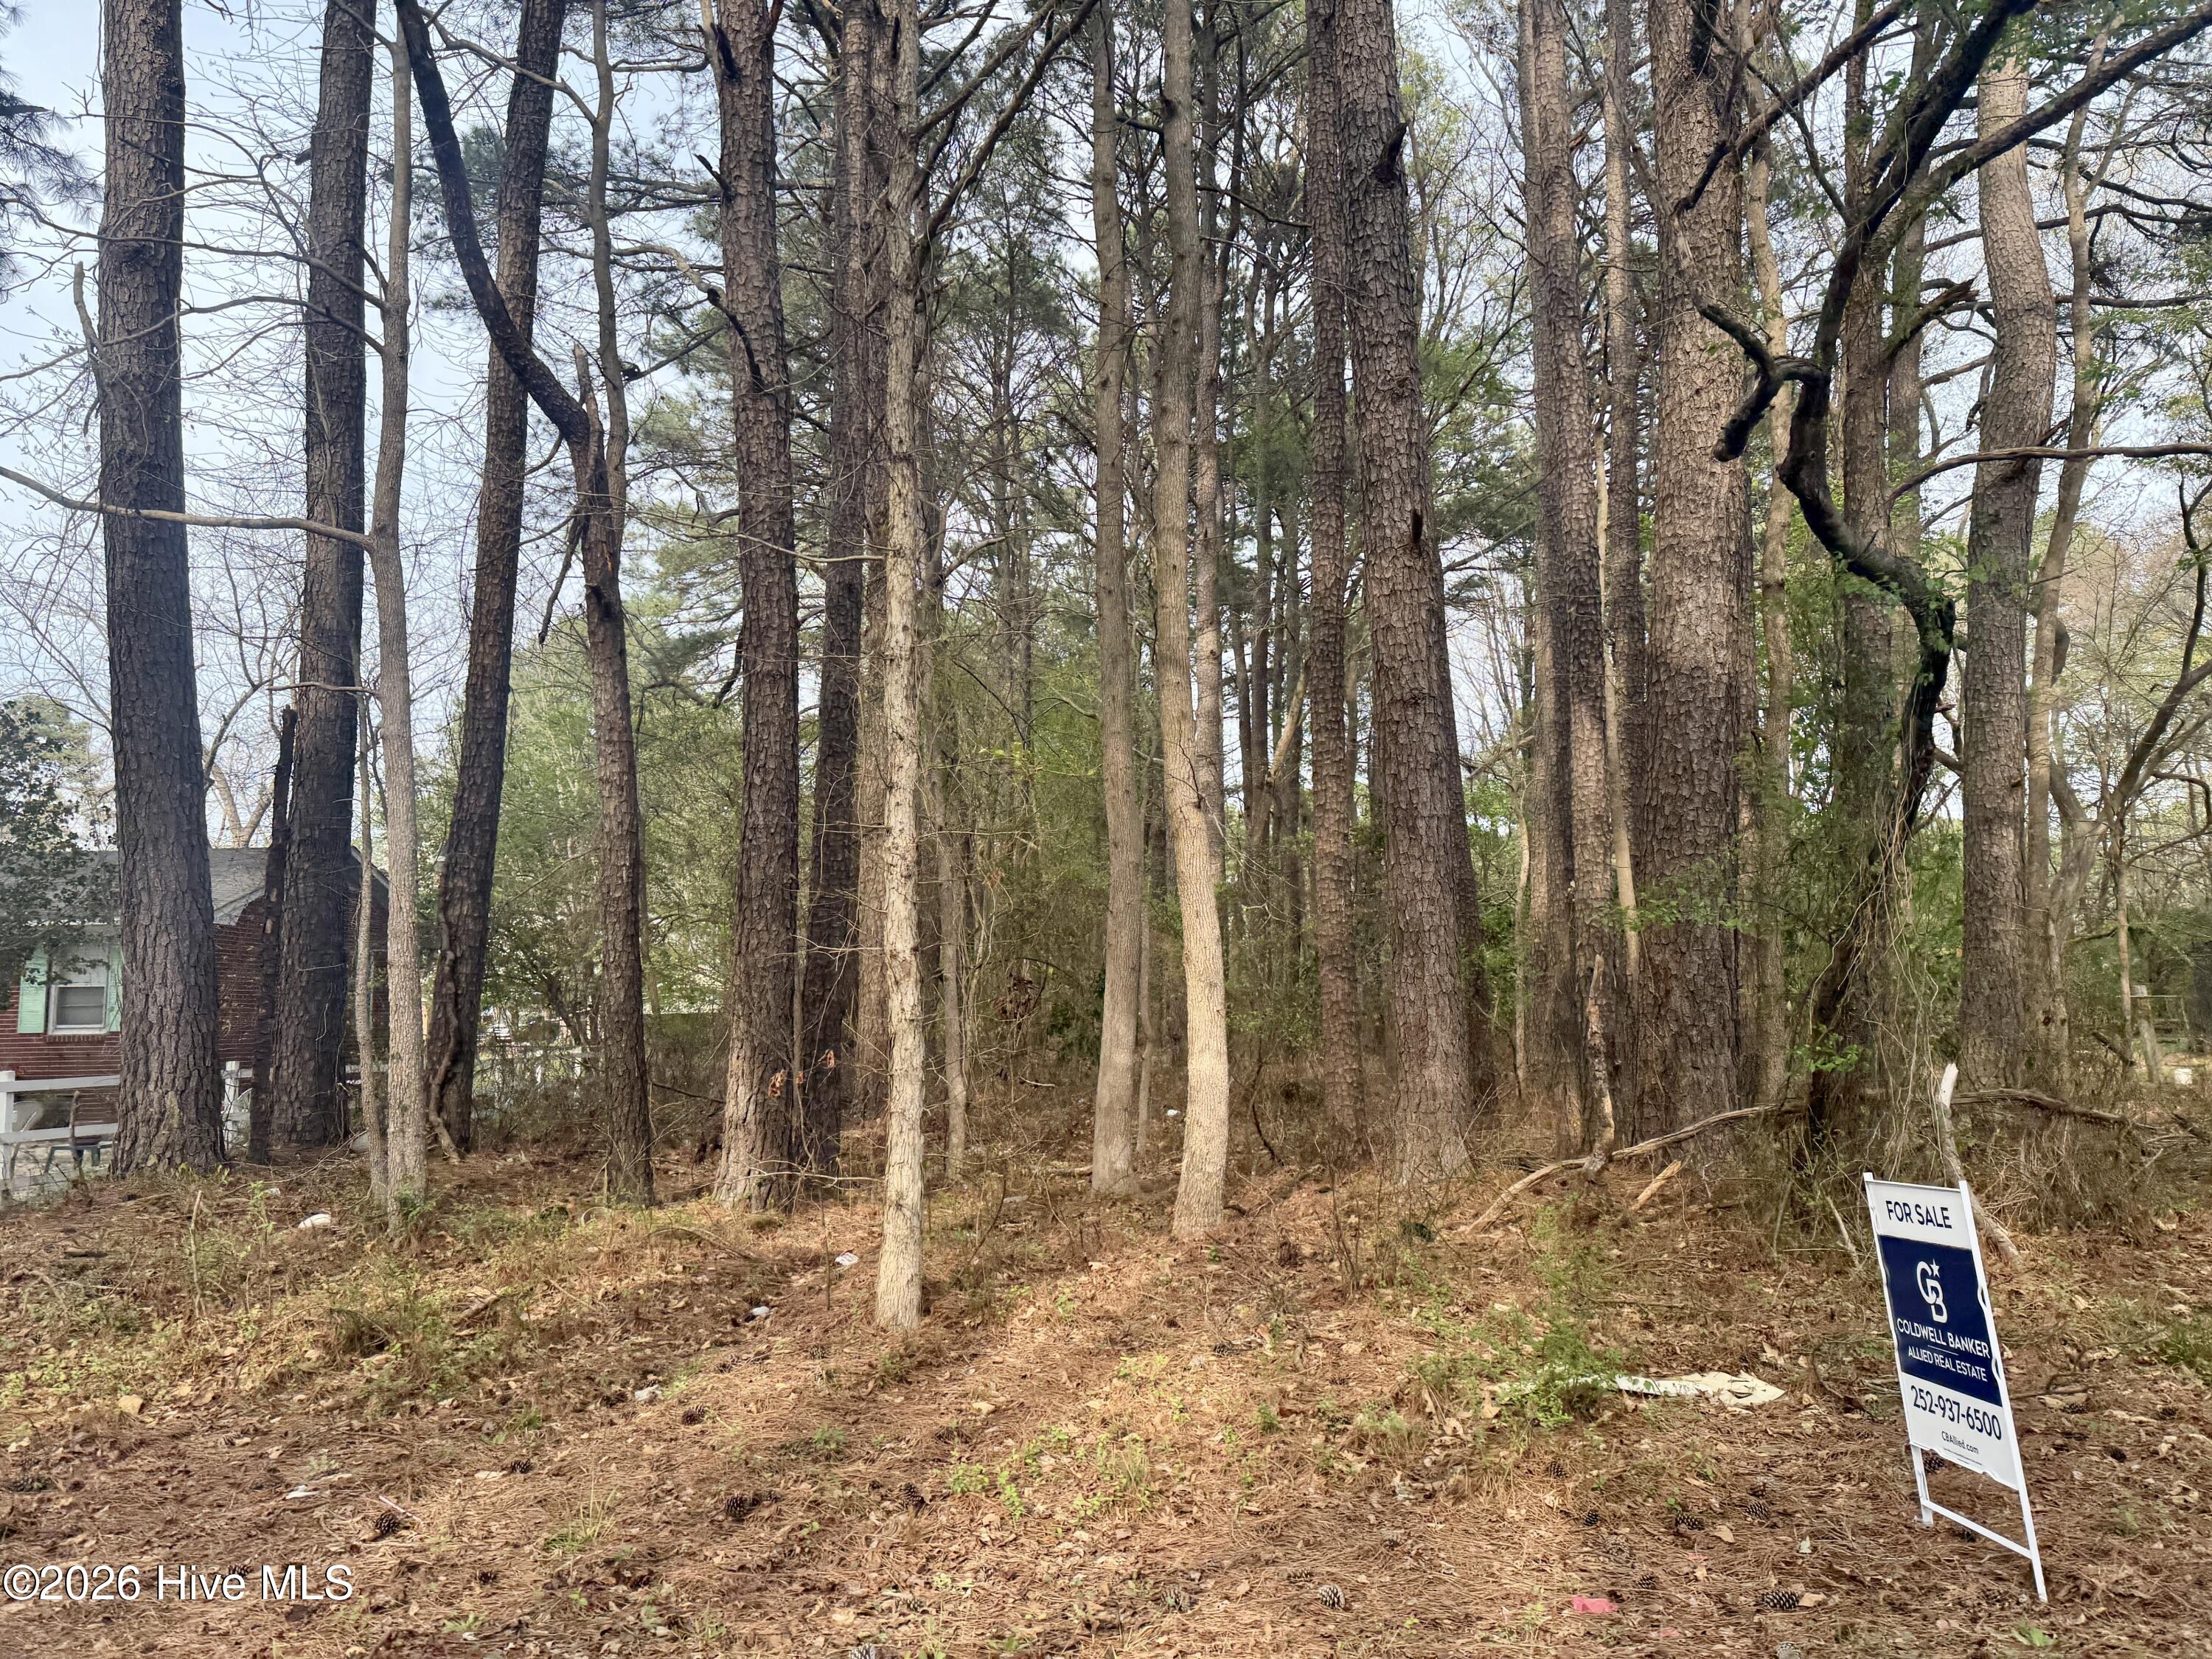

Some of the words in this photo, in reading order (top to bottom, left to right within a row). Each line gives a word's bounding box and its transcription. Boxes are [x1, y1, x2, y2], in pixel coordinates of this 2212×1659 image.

[1885, 1200, 1914, 1224] FOR
[1915, 1203, 1952, 1229] SALE
[1896, 1318, 1947, 1346] COLDWELL
[1947, 1332, 1991, 1359] BANKER
[1908, 1346, 1933, 1364] ALLIED
[1933, 1353, 1956, 1371] REAL
[1956, 1360, 1988, 1382] ESTATE
[1910, 1385, 2002, 1441] 252-937-6500
[1941, 1430, 1979, 1455] CBAllied.com
